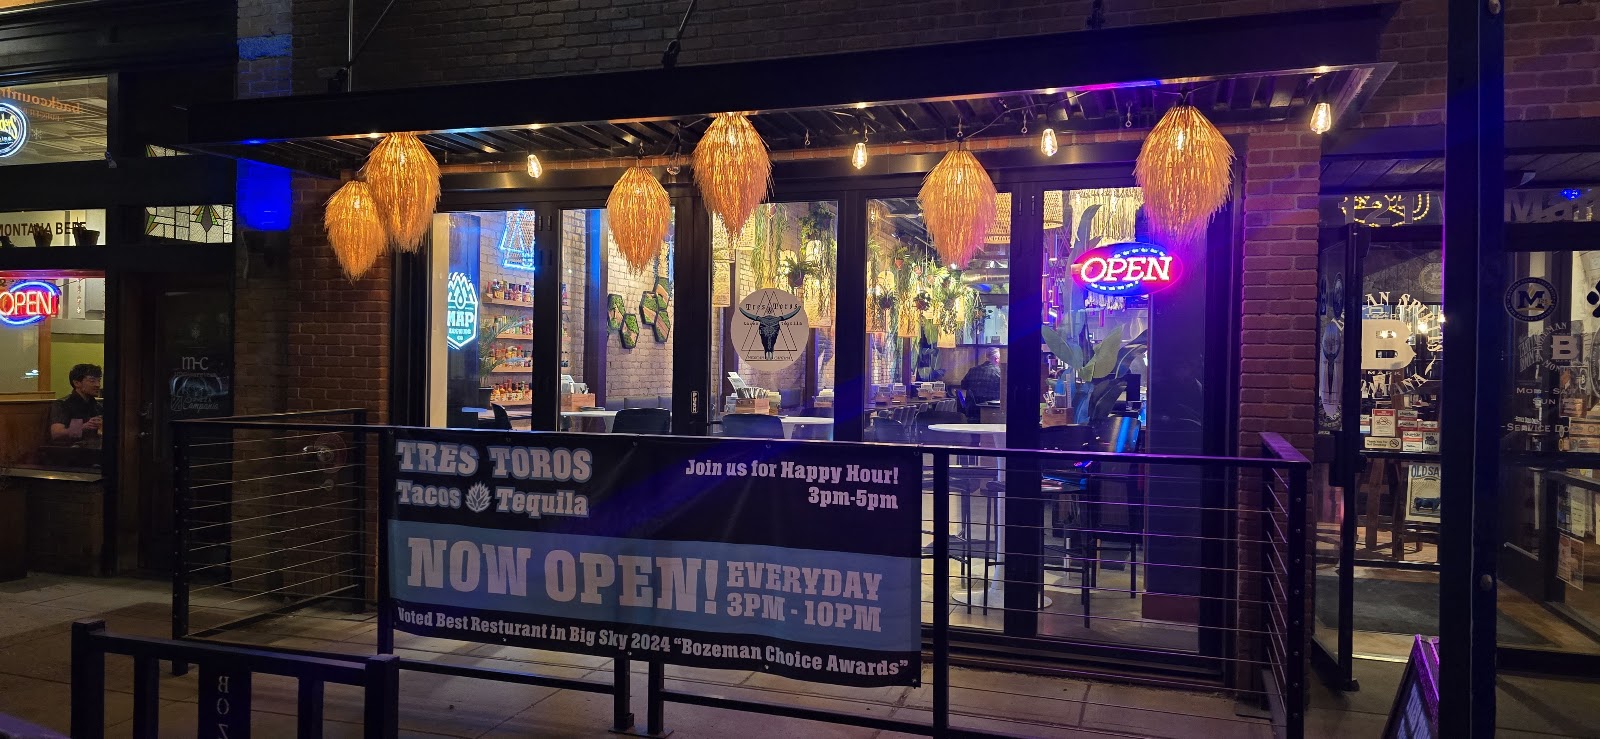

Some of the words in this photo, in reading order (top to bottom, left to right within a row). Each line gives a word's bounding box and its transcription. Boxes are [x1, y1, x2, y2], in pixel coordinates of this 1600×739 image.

[1080, 255, 1173, 283] OPEN
[0, 291, 52, 315] OPEN
[447, 310, 475, 327] MAP
[396, 440, 479, 476] TRES
[488, 446, 592, 482] TOROS
[686, 459, 722, 476] Join
[726, 461, 747, 477] us
[751, 459, 778, 478] for
[780, 461, 842, 484] Happy
[845, 464, 899, 485] Hour!
[396, 480, 461, 508] Tacos
[494, 487, 589, 518] Tequila
[808, 486, 898, 511] 3pm-5pm
[407, 537, 531, 597] NOW
[544, 549, 719, 615] OPEN!
[726, 560, 883, 601] EVERYDAY
[726, 592, 786, 622] 3PM
[804, 600, 882, 632] 10PM
[398, 606, 433, 627] Voted
[436, 612, 468, 631] Best
[471, 616, 547, 639] Resturant
[550, 624, 567, 640] in
[569, 626, 596, 647] Big
[599, 629, 628, 650] Sky
[631, 632, 671, 653] 2024
[765, 645, 823, 670] Choice
